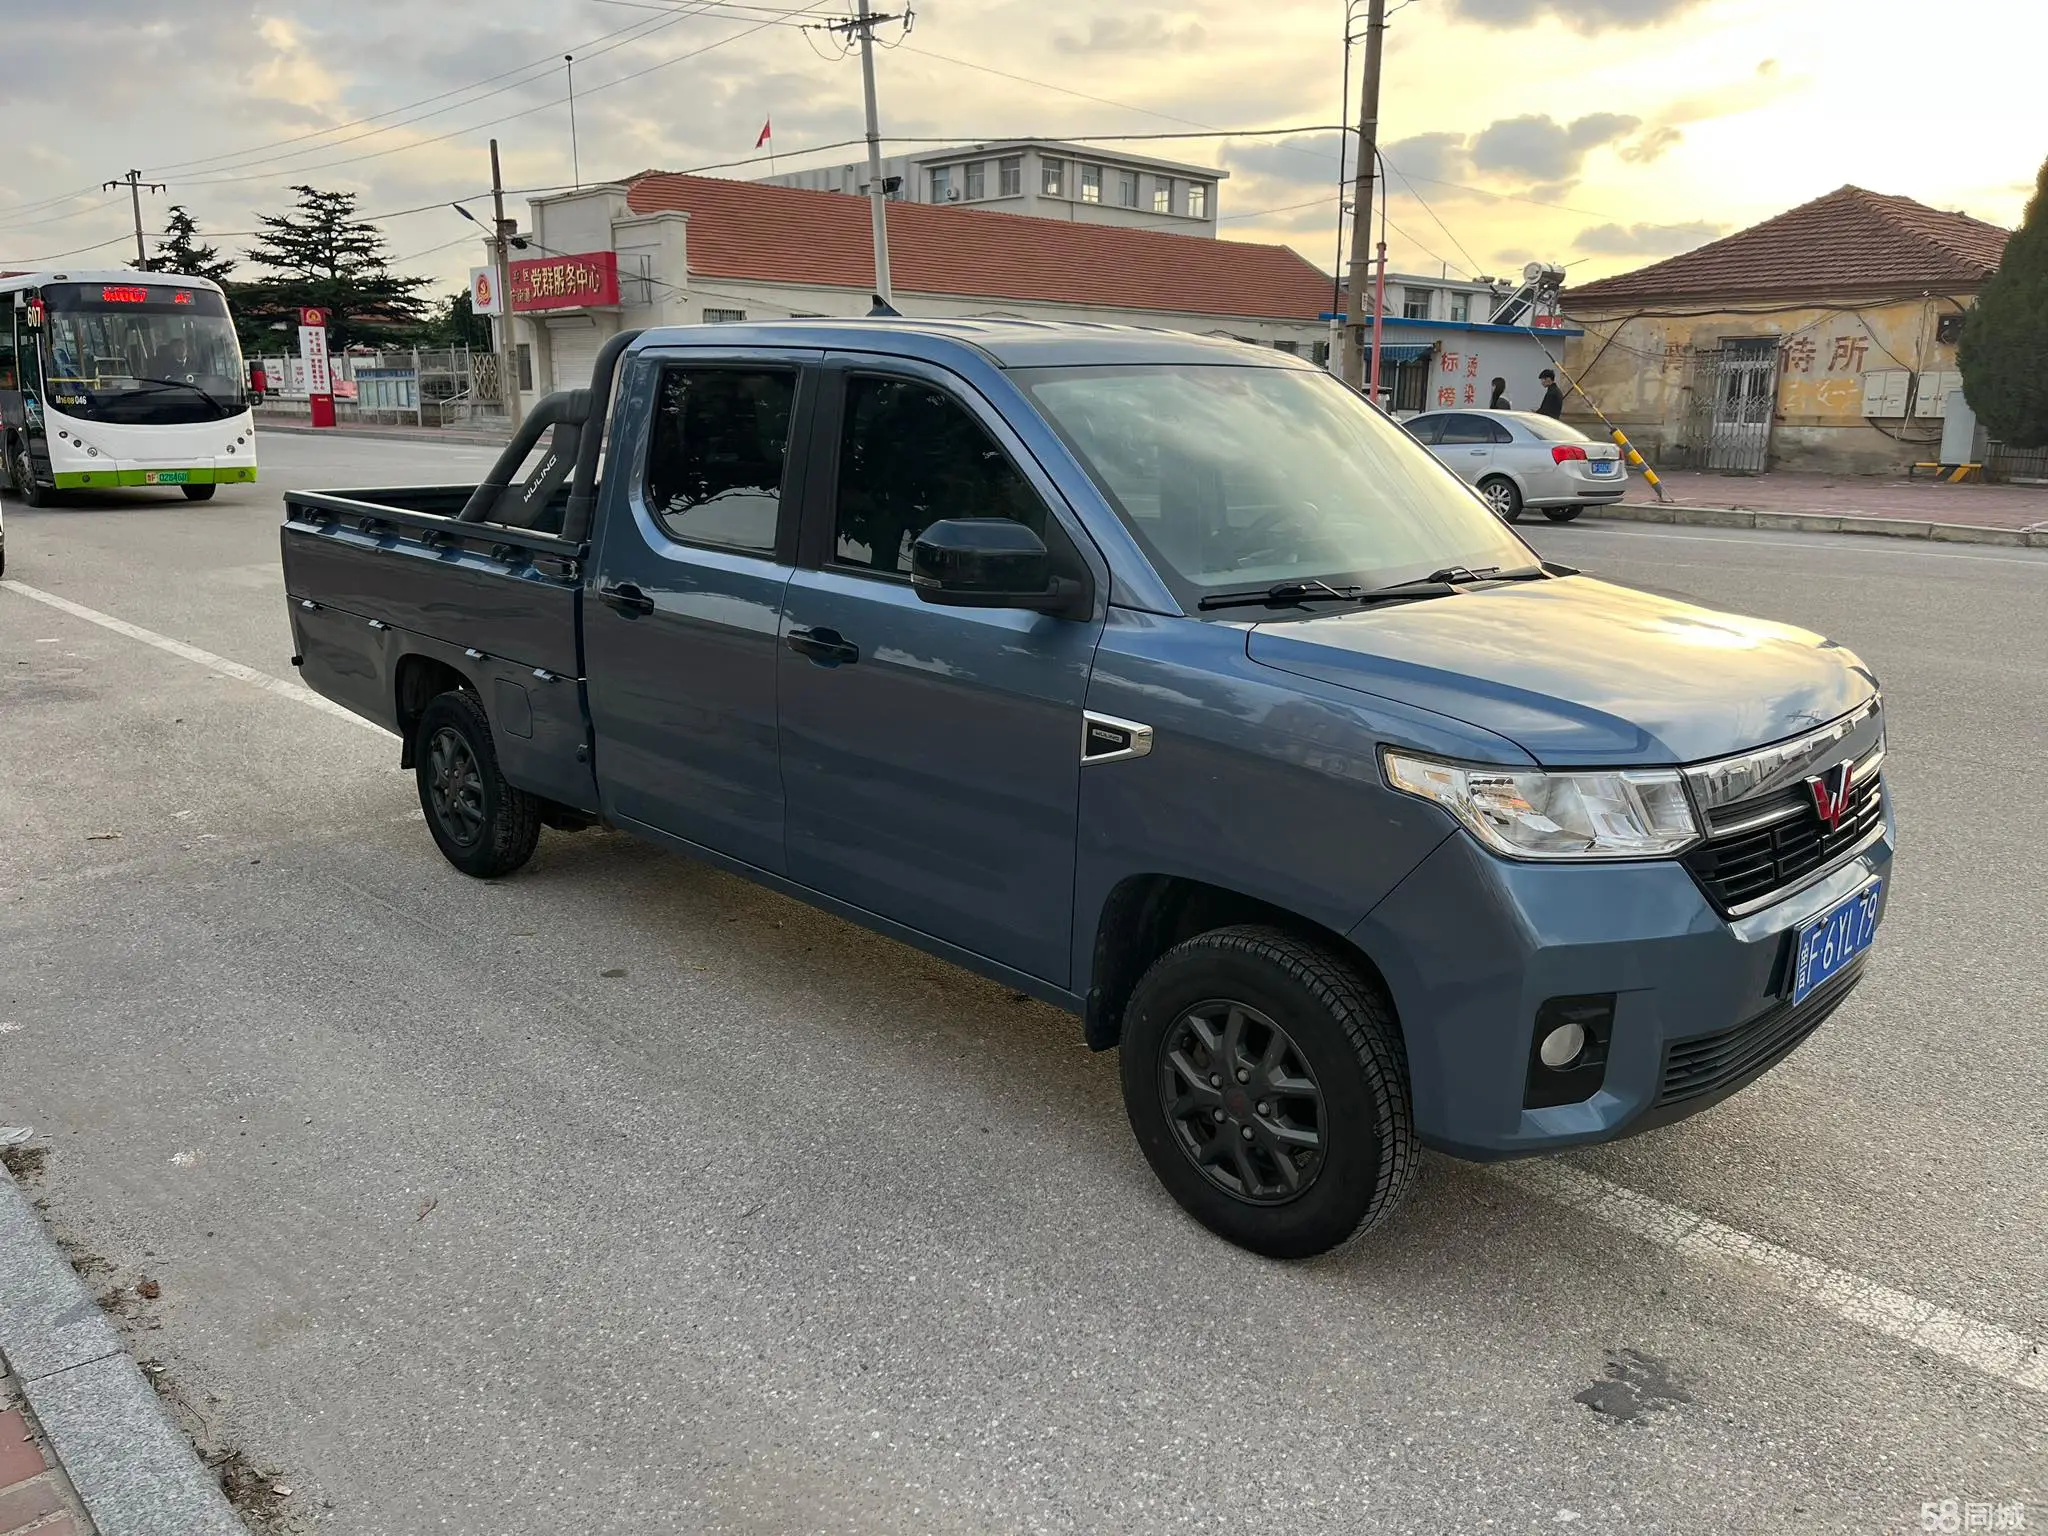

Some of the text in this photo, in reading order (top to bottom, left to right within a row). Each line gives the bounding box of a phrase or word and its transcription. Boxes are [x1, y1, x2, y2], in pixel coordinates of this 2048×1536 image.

[531, 263, 600, 297] 党群服务中心
[28, 306, 41, 327] 607
[523, 454, 557, 503] WULING
